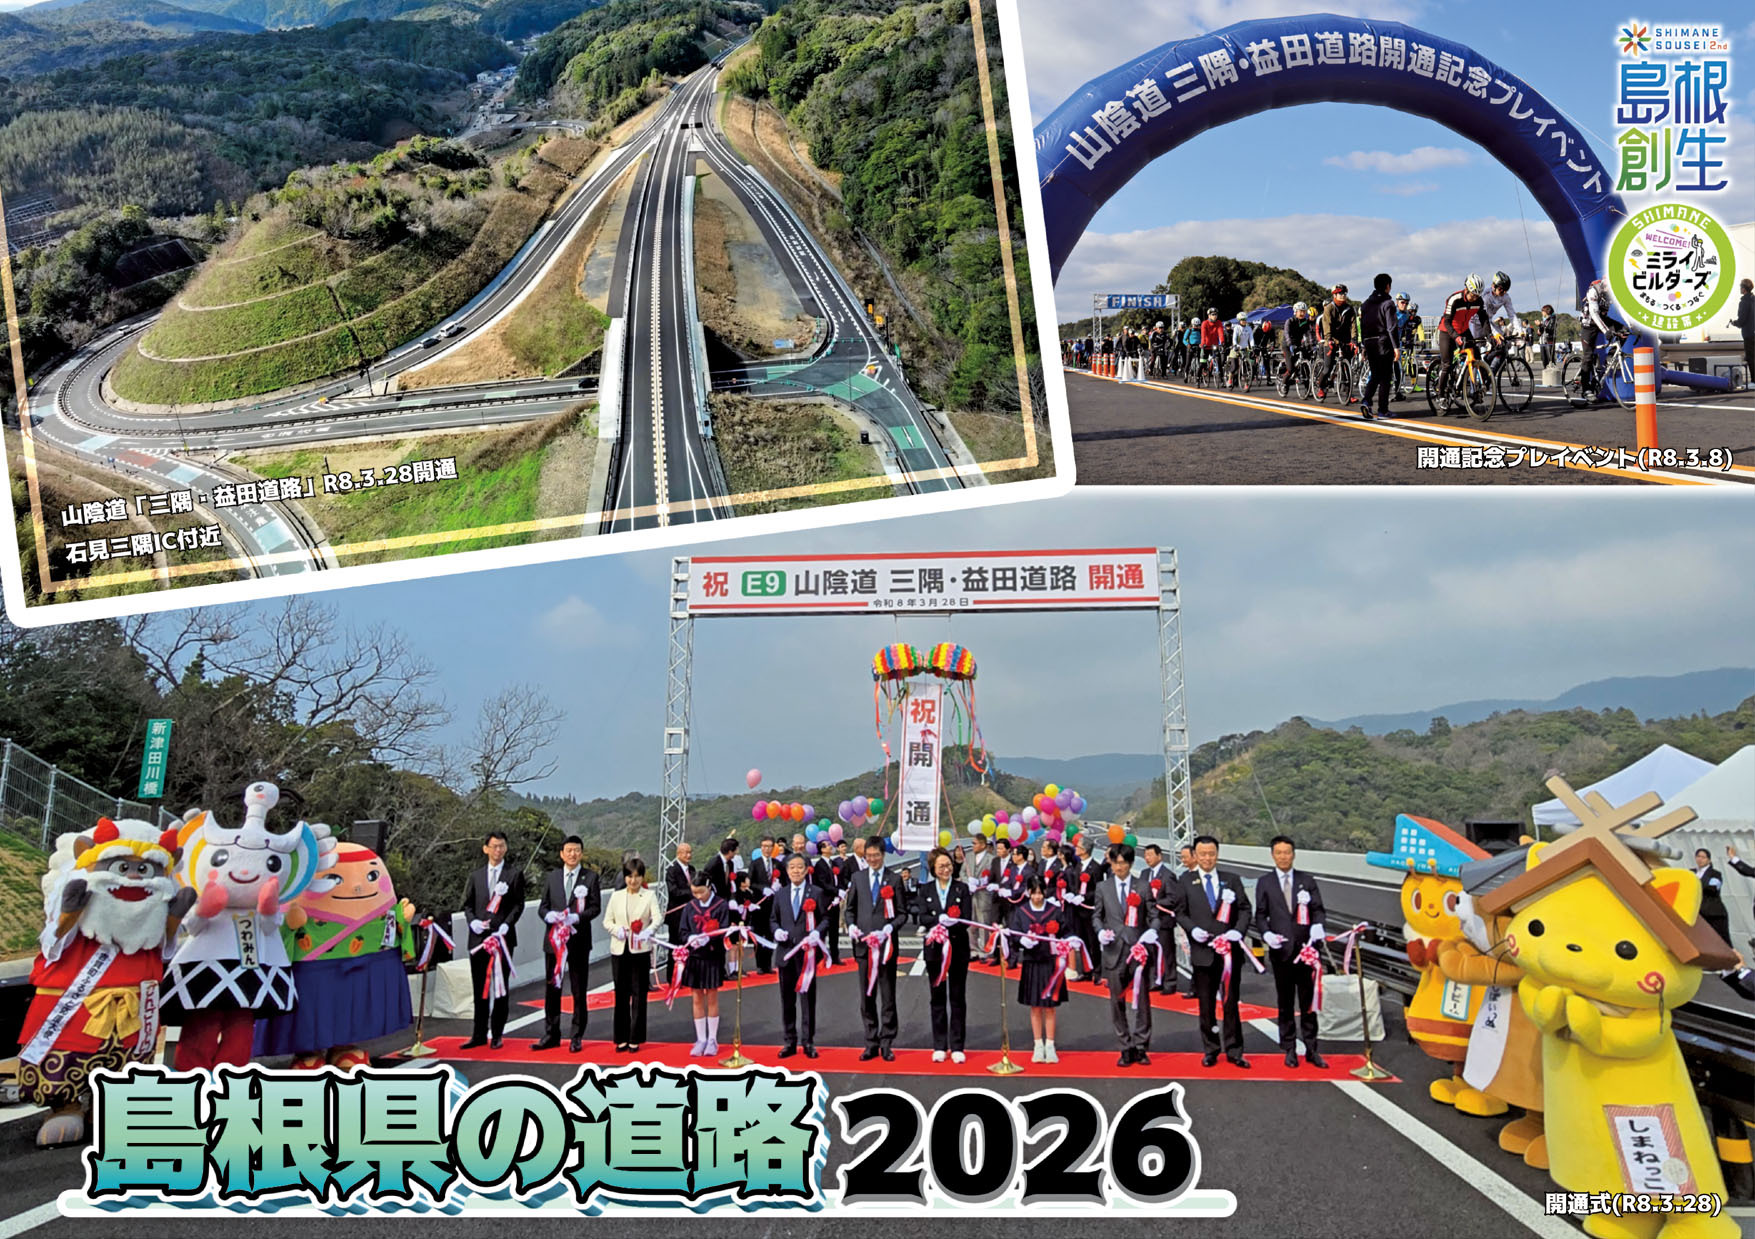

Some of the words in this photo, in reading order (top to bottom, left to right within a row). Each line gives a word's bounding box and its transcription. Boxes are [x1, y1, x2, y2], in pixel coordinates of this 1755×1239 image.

[1065, 79, 1172, 171] 山陰道
[1112, 296, 1162, 308] FINISH
[703, 571, 729, 597] 祝
[746, 573, 780, 594] E9
[795, 570, 878, 596] 山陰道
[889, 565, 1077, 595] 三隅・益田道路
[1089, 563, 1145, 590] 開通
[144, 721, 167, 795] 新津田川橋
[239, 919, 256, 966] つわみん
[1629, 1119, 1665, 1191] しまねっこ
